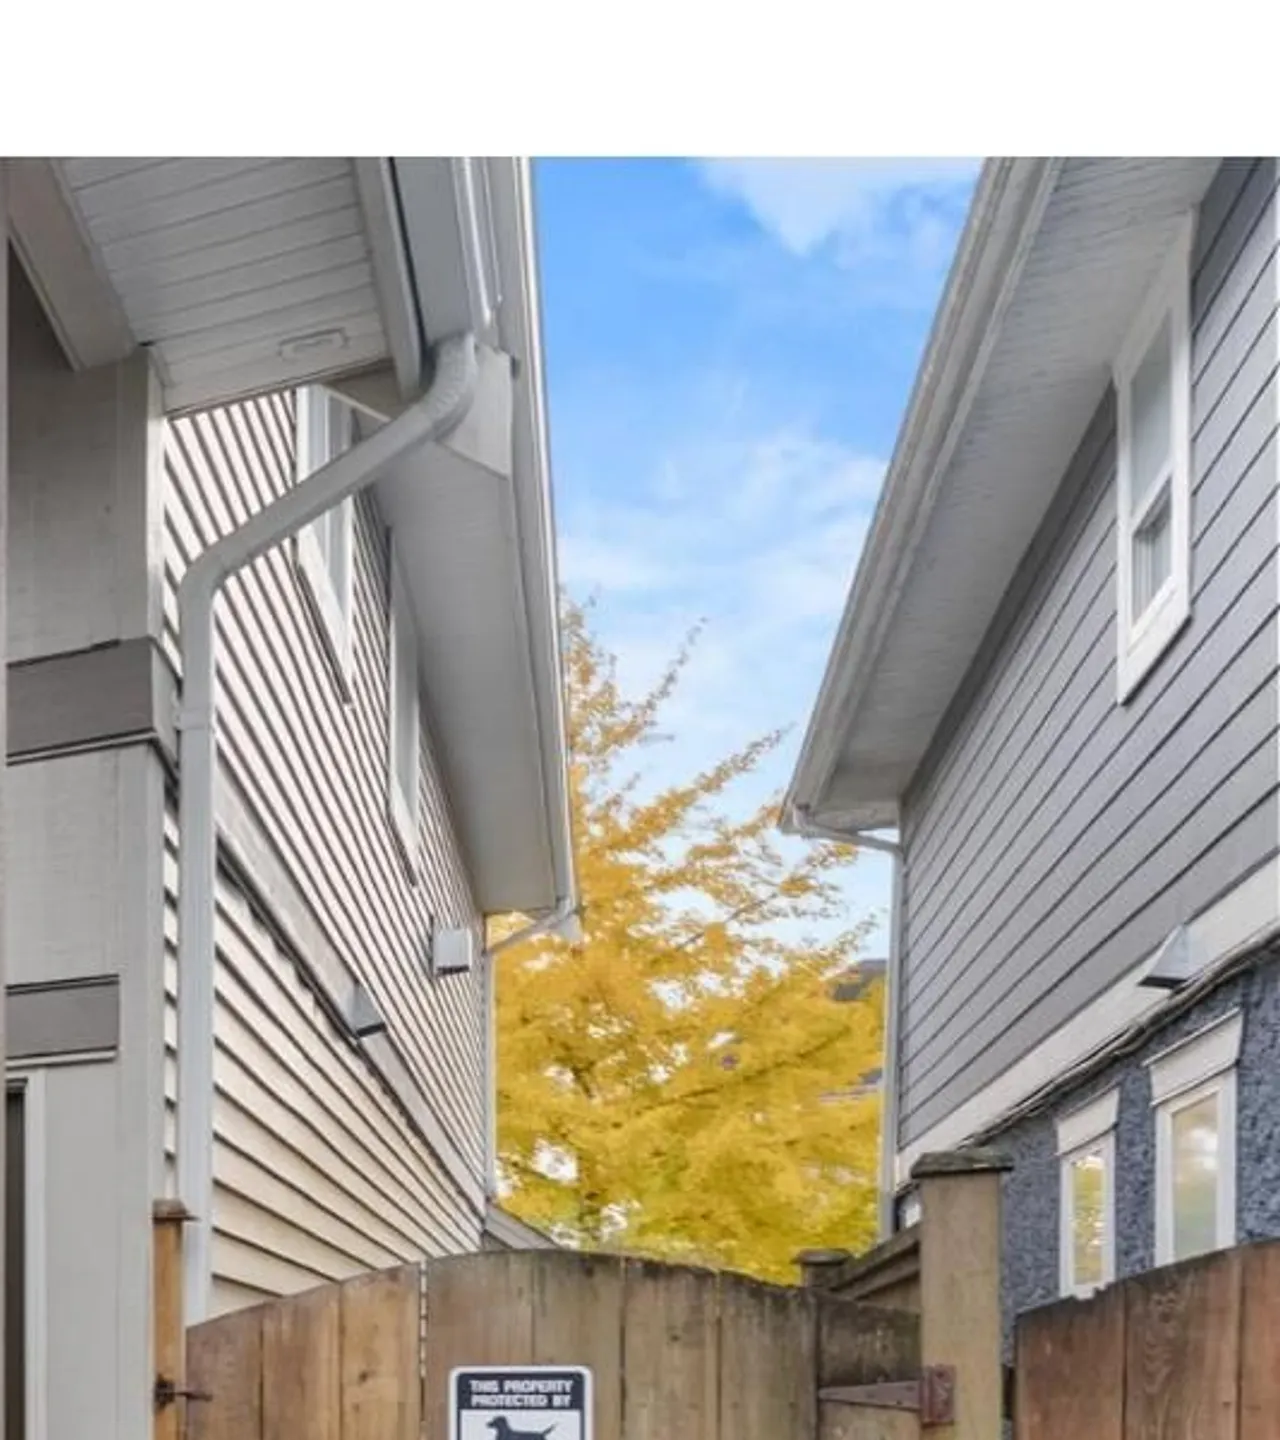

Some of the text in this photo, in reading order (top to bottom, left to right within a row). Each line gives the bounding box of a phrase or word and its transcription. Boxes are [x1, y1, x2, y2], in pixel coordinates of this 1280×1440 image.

[469, 1379, 573, 1393] THIS PROPERTY
[471, 1394, 571, 1407] PROTECTED BY
